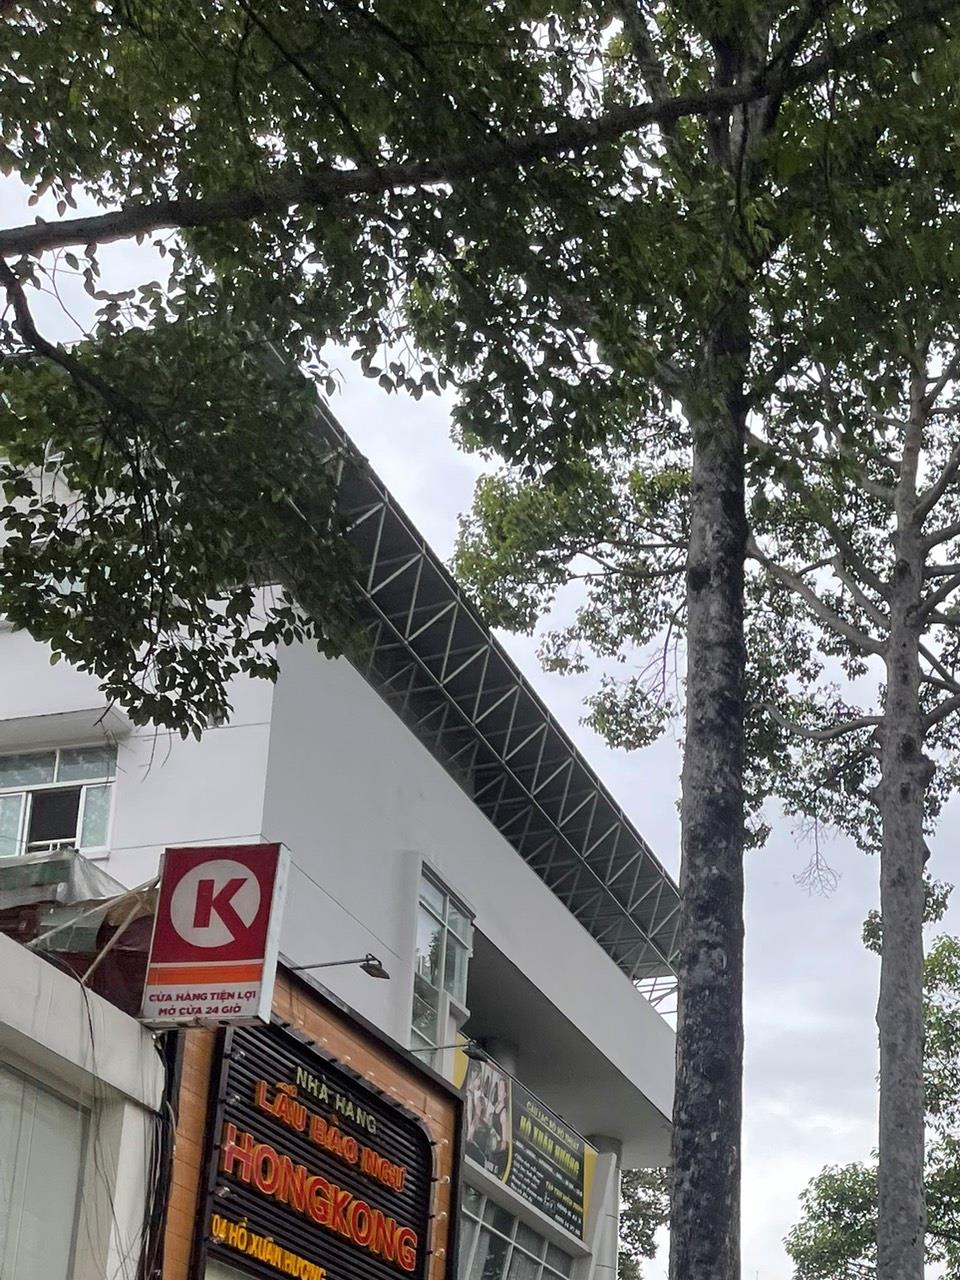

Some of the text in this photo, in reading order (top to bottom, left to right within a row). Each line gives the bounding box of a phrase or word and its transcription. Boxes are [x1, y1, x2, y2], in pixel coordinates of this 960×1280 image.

[192, 878, 249, 942] K
[149, 989, 256, 1003] CỬA HÀNG TIỆN LỢI
[158, 1003, 241, 1016] MỞ CỬA 24 GIỜ
[296, 1067, 329, 1103] NHÀ
[223, 1122, 418, 1271] HONGKONG
[228, 1216, 248, 1251] HỒ
[247, 1237, 284, 1270] XUÂN
